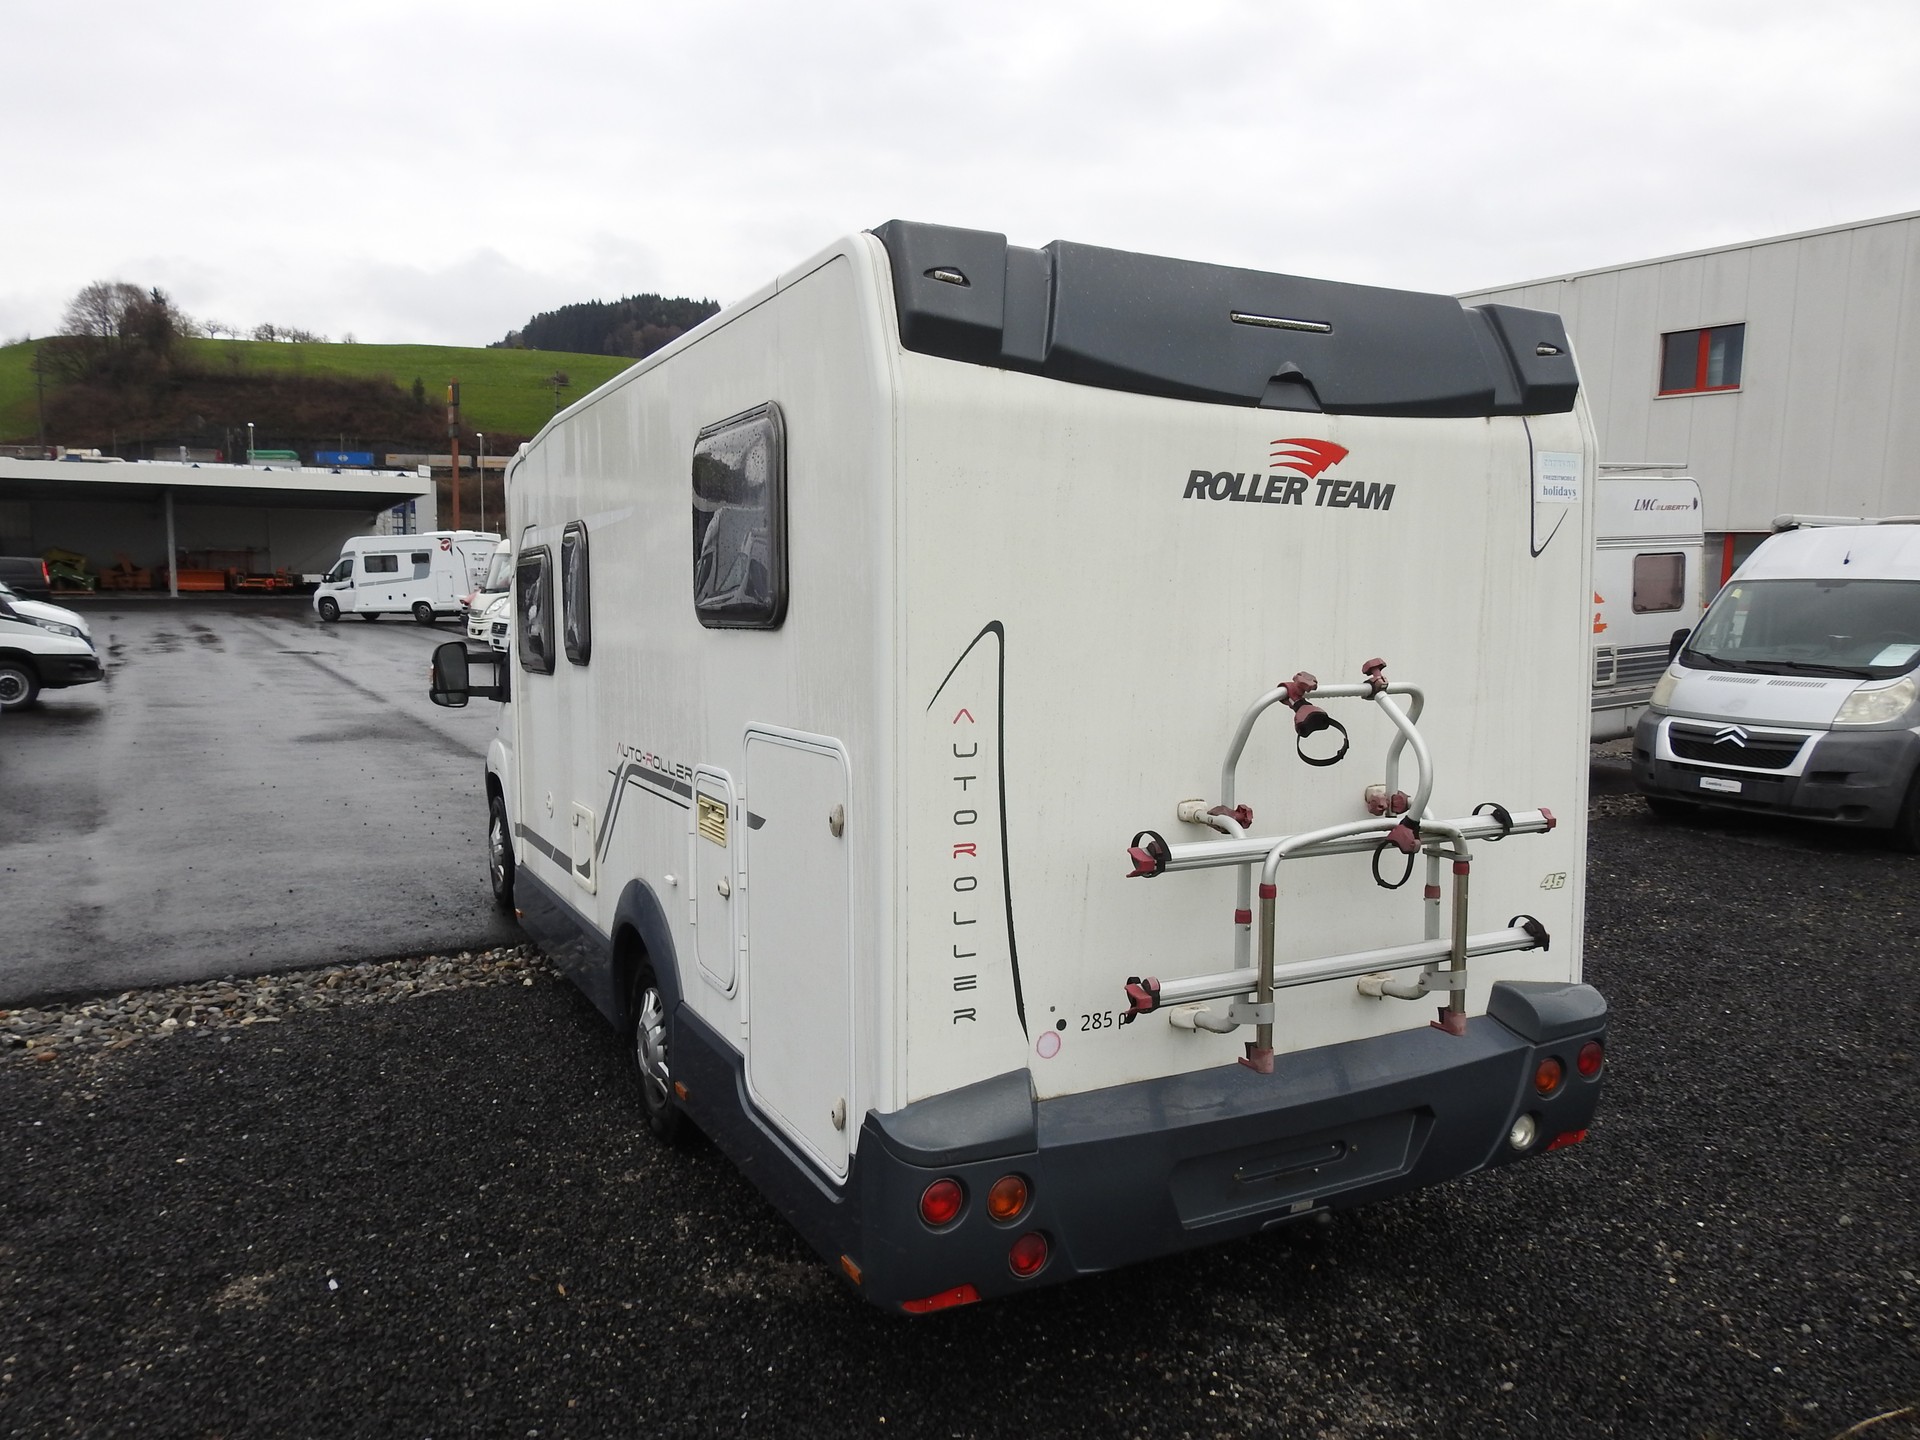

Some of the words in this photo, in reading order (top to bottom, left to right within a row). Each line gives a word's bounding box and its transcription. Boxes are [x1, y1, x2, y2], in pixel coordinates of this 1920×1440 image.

[1183, 470, 1309, 505] ROLLER
[1315, 478, 1396, 511] TEAM
[1542, 485, 1577, 499] holidays
[1633, 498, 1658, 511] LMC
[616, 742, 693, 782] AUTO-ROLLER
[1539, 871, 1567, 890] 46
[1081, 1010, 1113, 1032] 285
